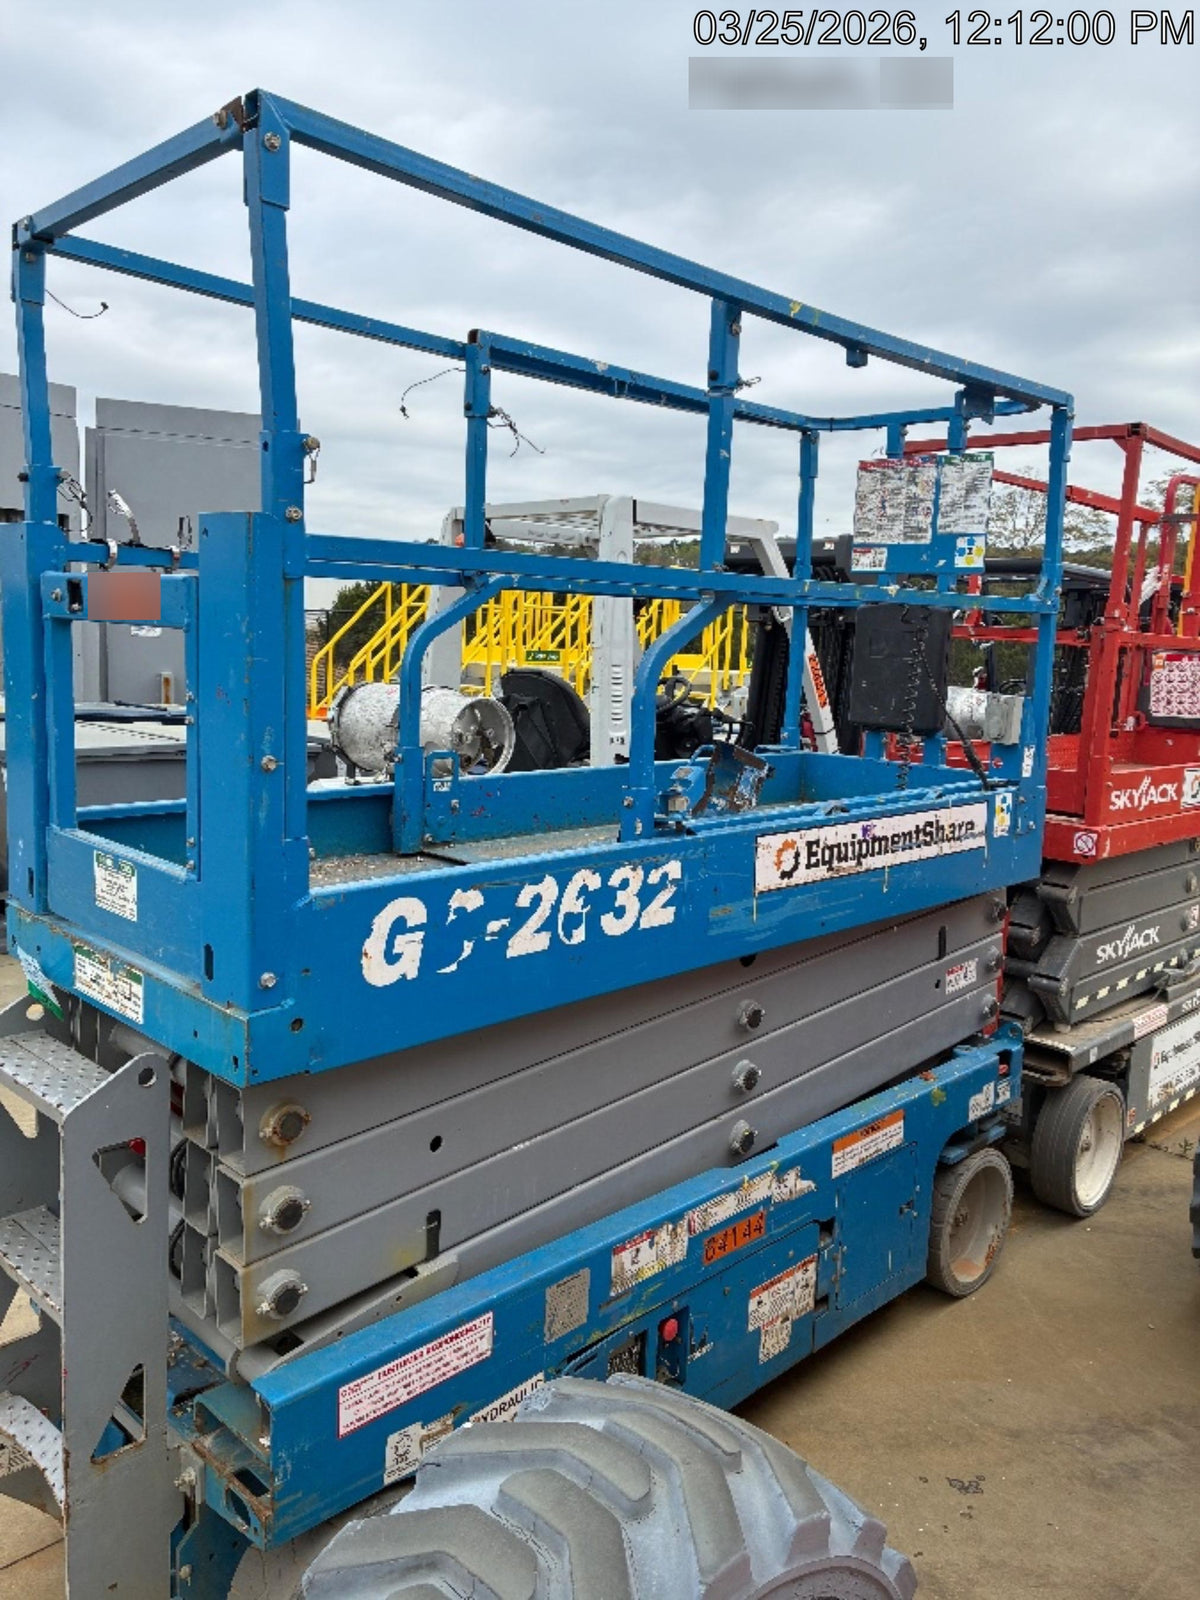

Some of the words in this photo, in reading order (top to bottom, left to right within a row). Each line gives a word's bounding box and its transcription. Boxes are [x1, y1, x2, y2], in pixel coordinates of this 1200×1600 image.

[1109, 775, 1178, 811] SKYJACK
[804, 818, 976, 874] EquipmentShare
[1096, 924, 1160, 964] SKYJACK
[473, 1379, 543, 1423] YDRAUI
